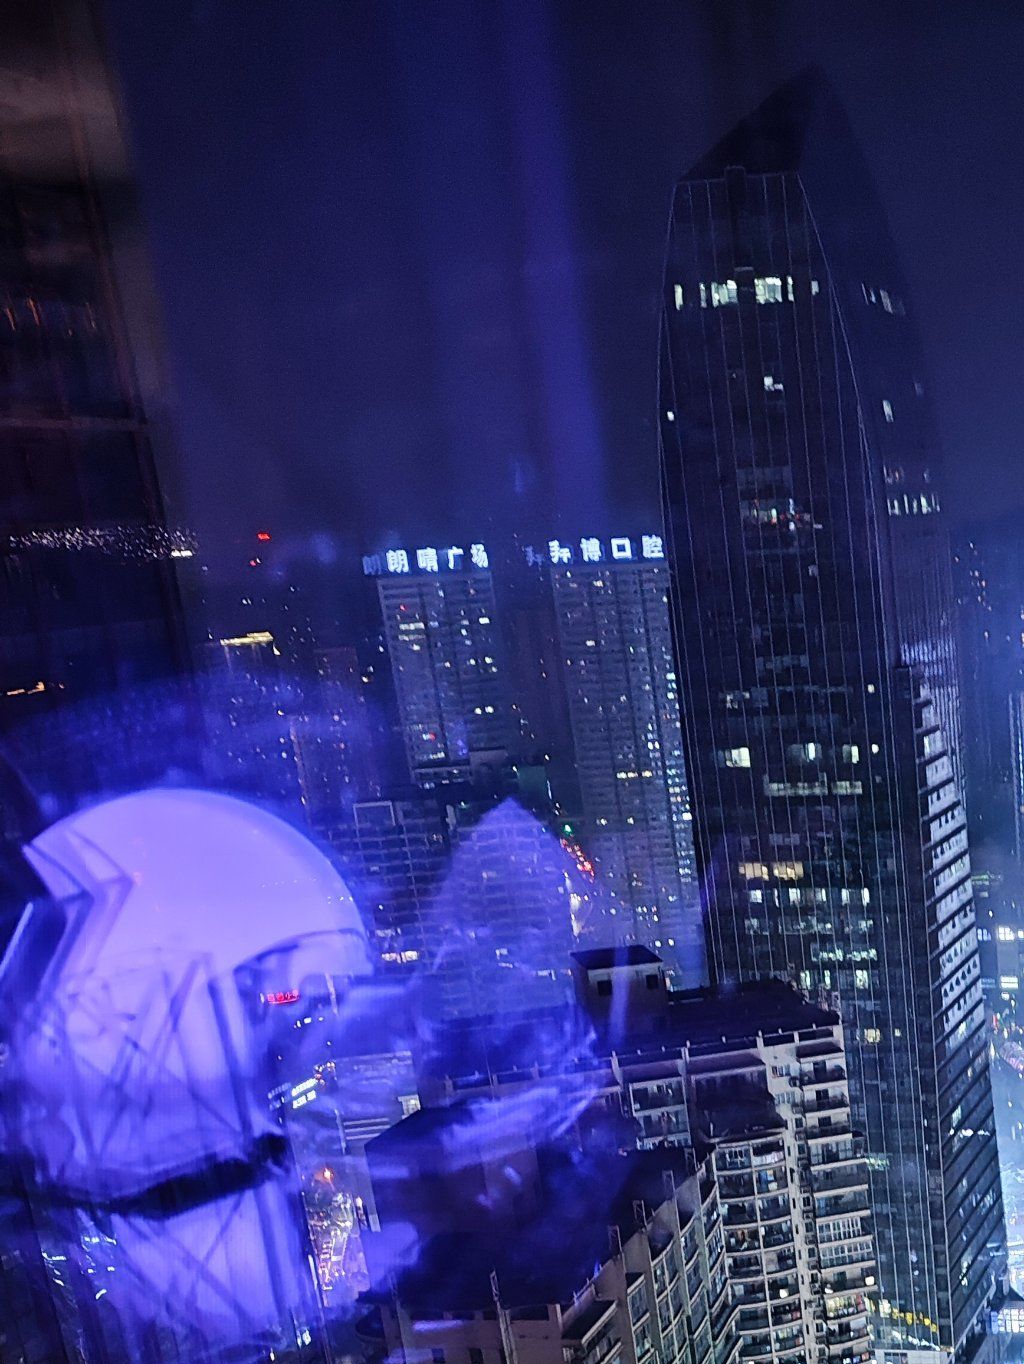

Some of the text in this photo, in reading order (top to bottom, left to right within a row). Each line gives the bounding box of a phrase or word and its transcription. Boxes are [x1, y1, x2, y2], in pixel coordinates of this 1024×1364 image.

[385, 543, 489, 574] 朗晴广场
[548, 534, 665, 565] 拜博口腔
